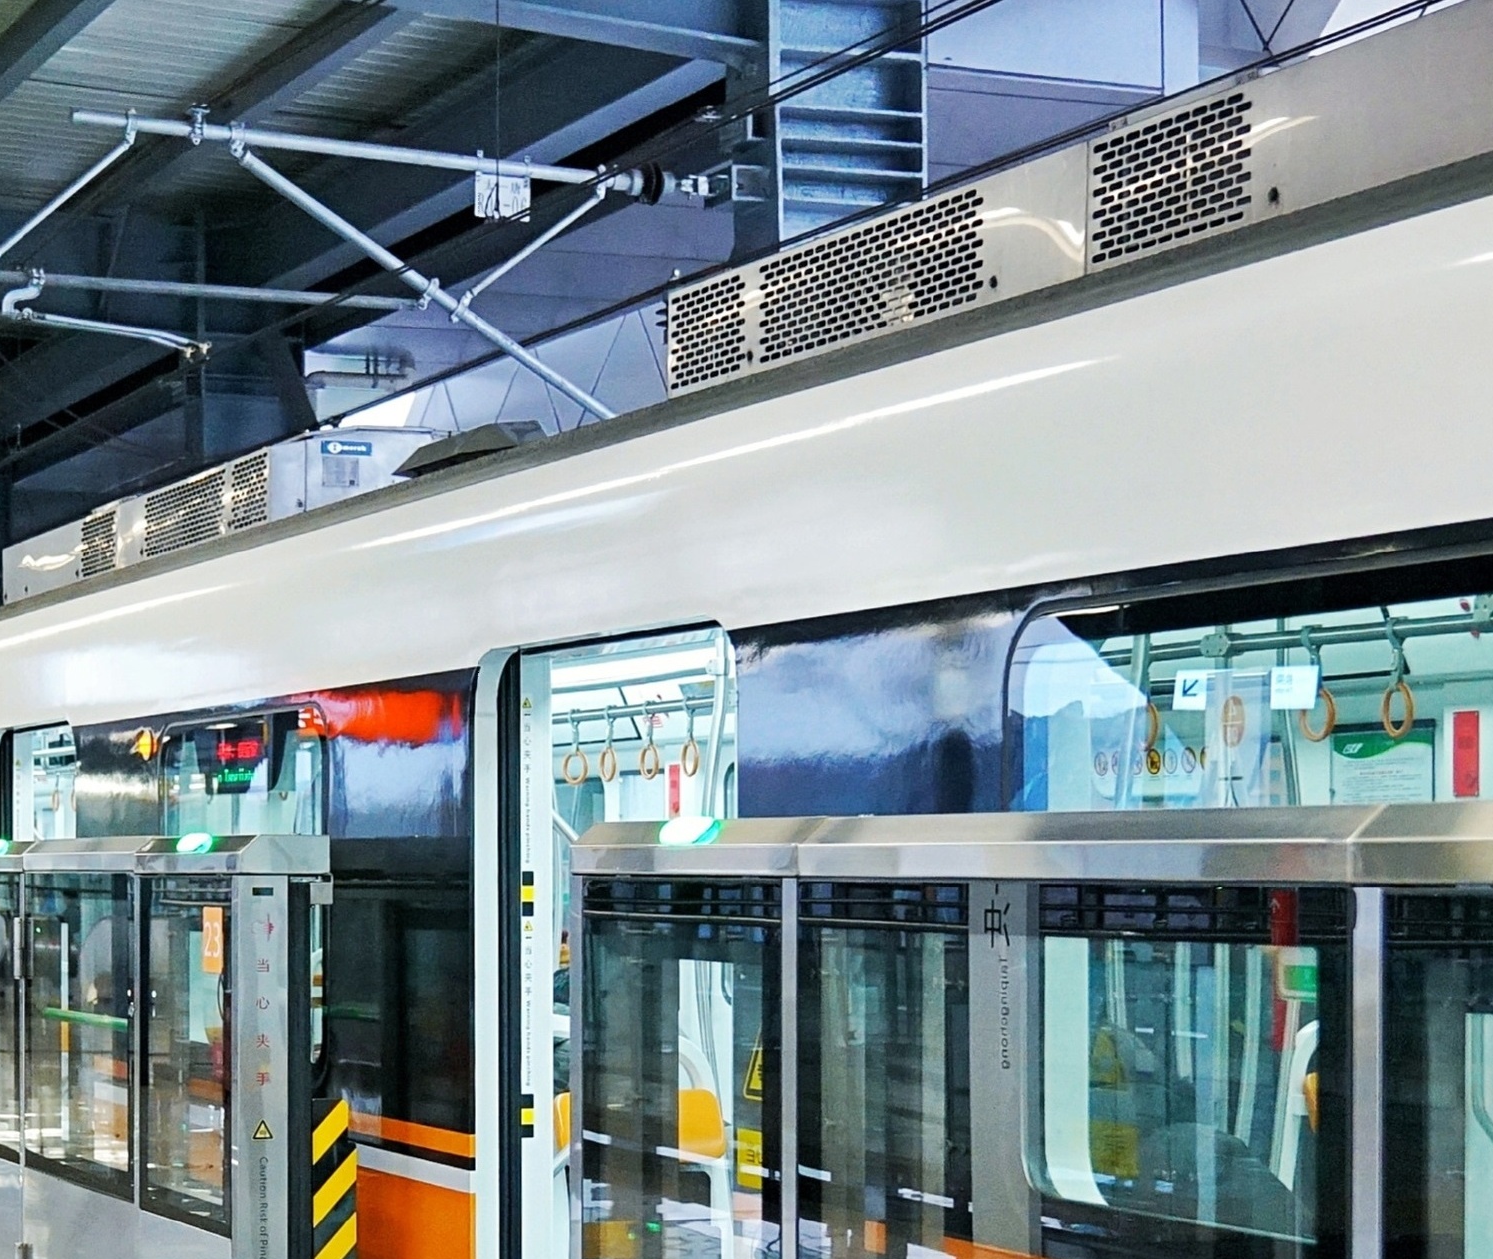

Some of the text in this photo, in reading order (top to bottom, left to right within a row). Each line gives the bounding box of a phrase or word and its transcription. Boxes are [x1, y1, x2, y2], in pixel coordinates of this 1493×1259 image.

[203, 921, 220, 958] 23
[256, 958, 270, 1087] 当心夹手
